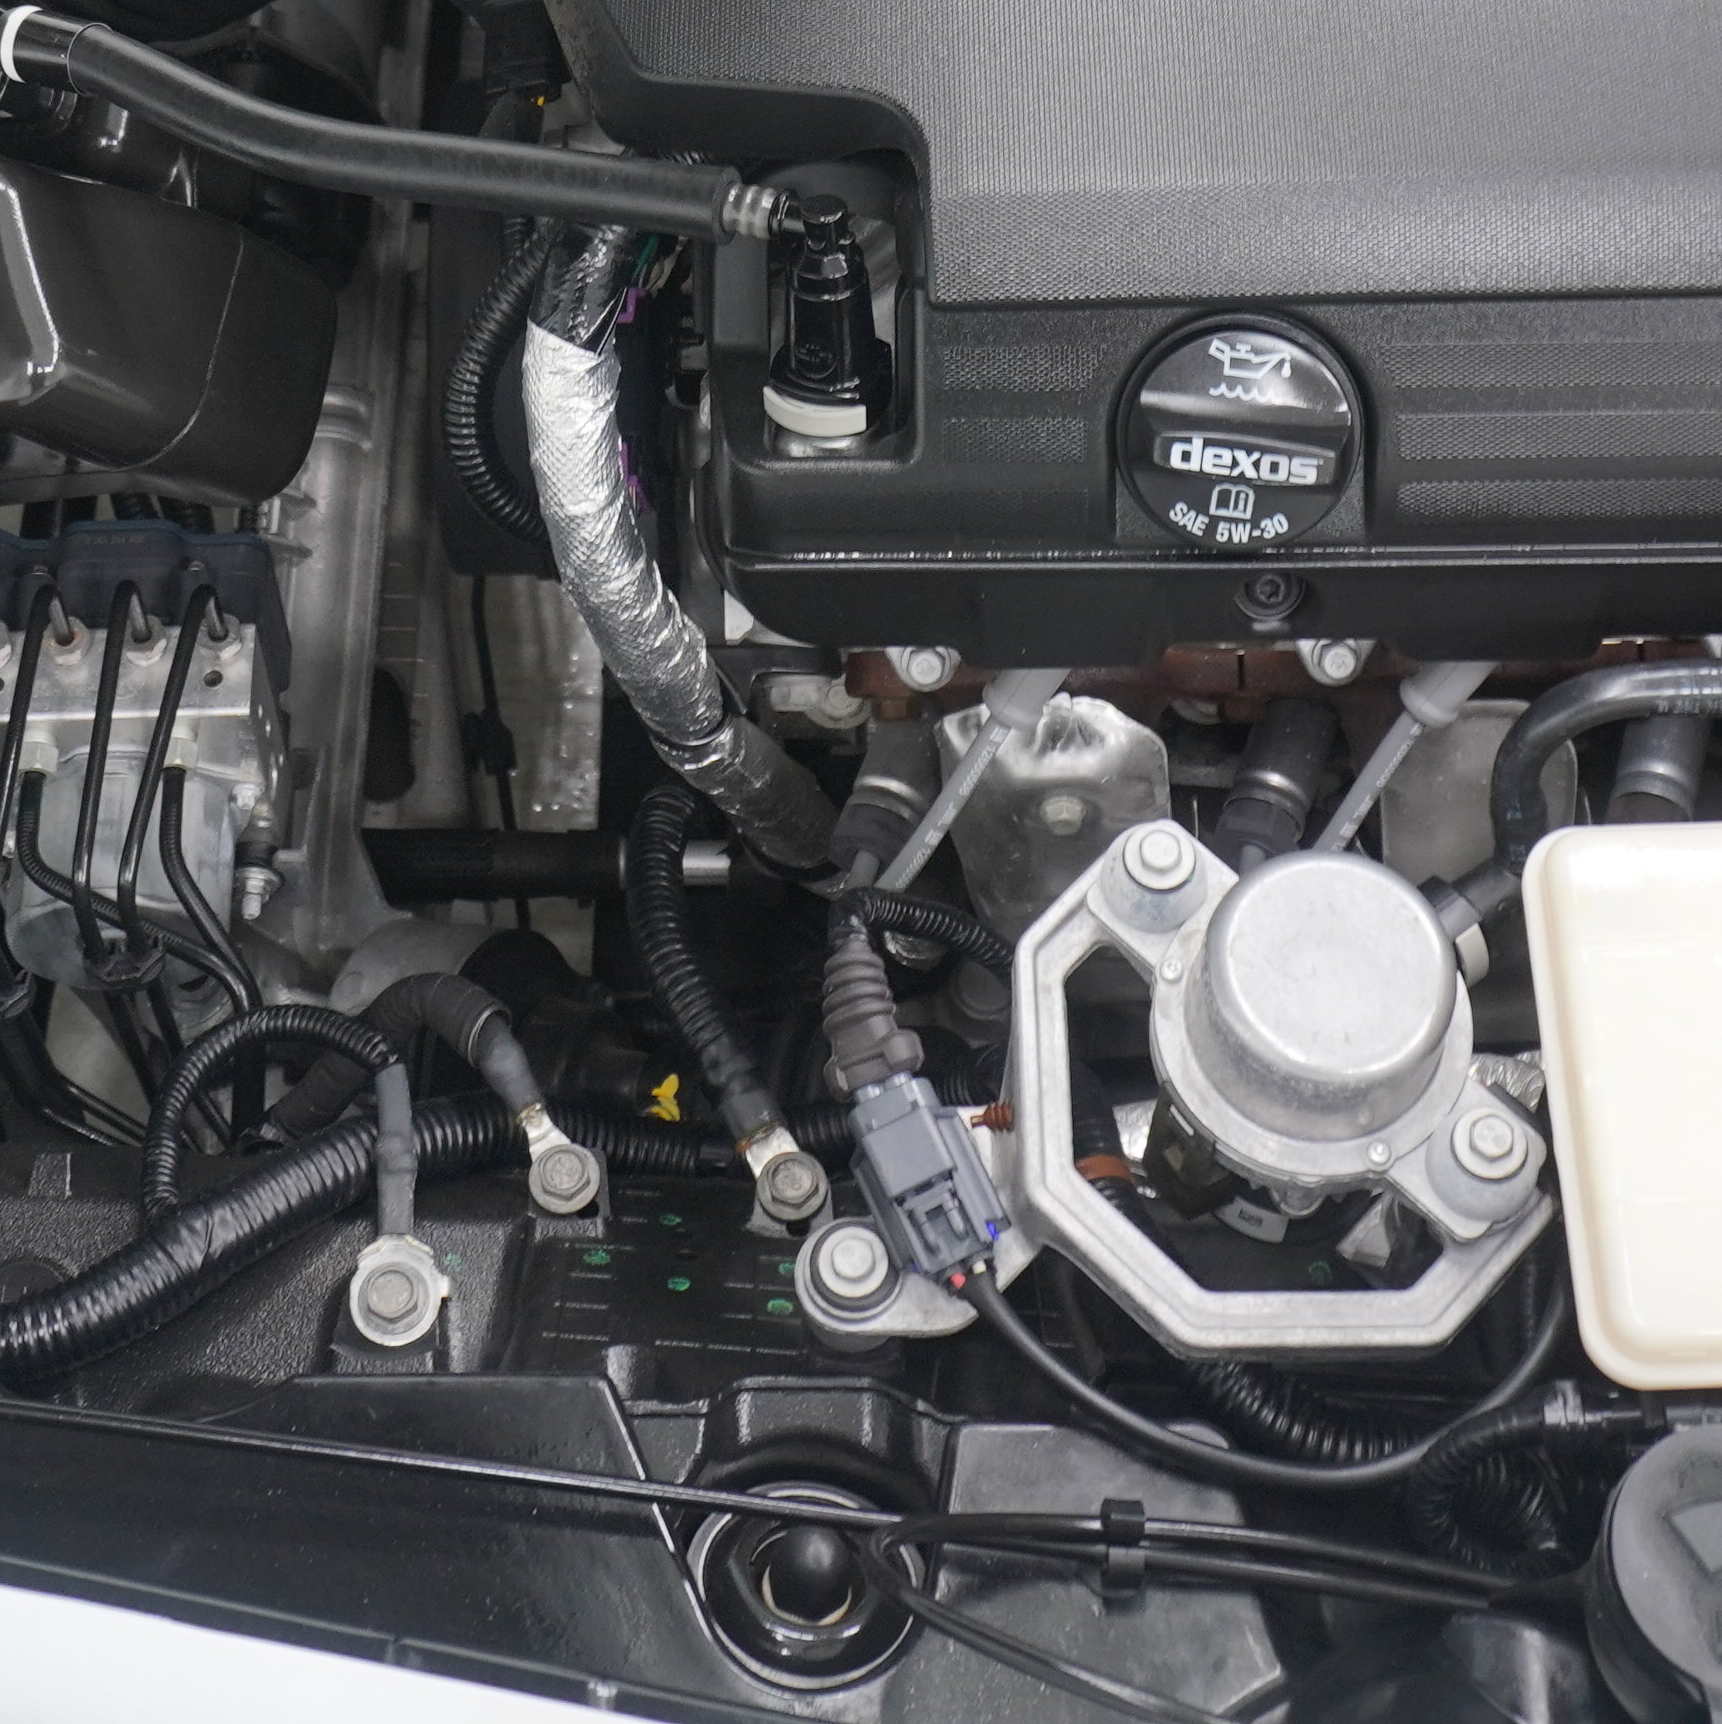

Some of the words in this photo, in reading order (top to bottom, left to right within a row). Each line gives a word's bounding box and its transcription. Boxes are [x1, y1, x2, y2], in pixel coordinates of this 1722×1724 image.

[1170, 436, 1319, 486] dexos
[1169, 502, 1209, 536] SAE
[1216, 513, 1289, 544] 5W-30
